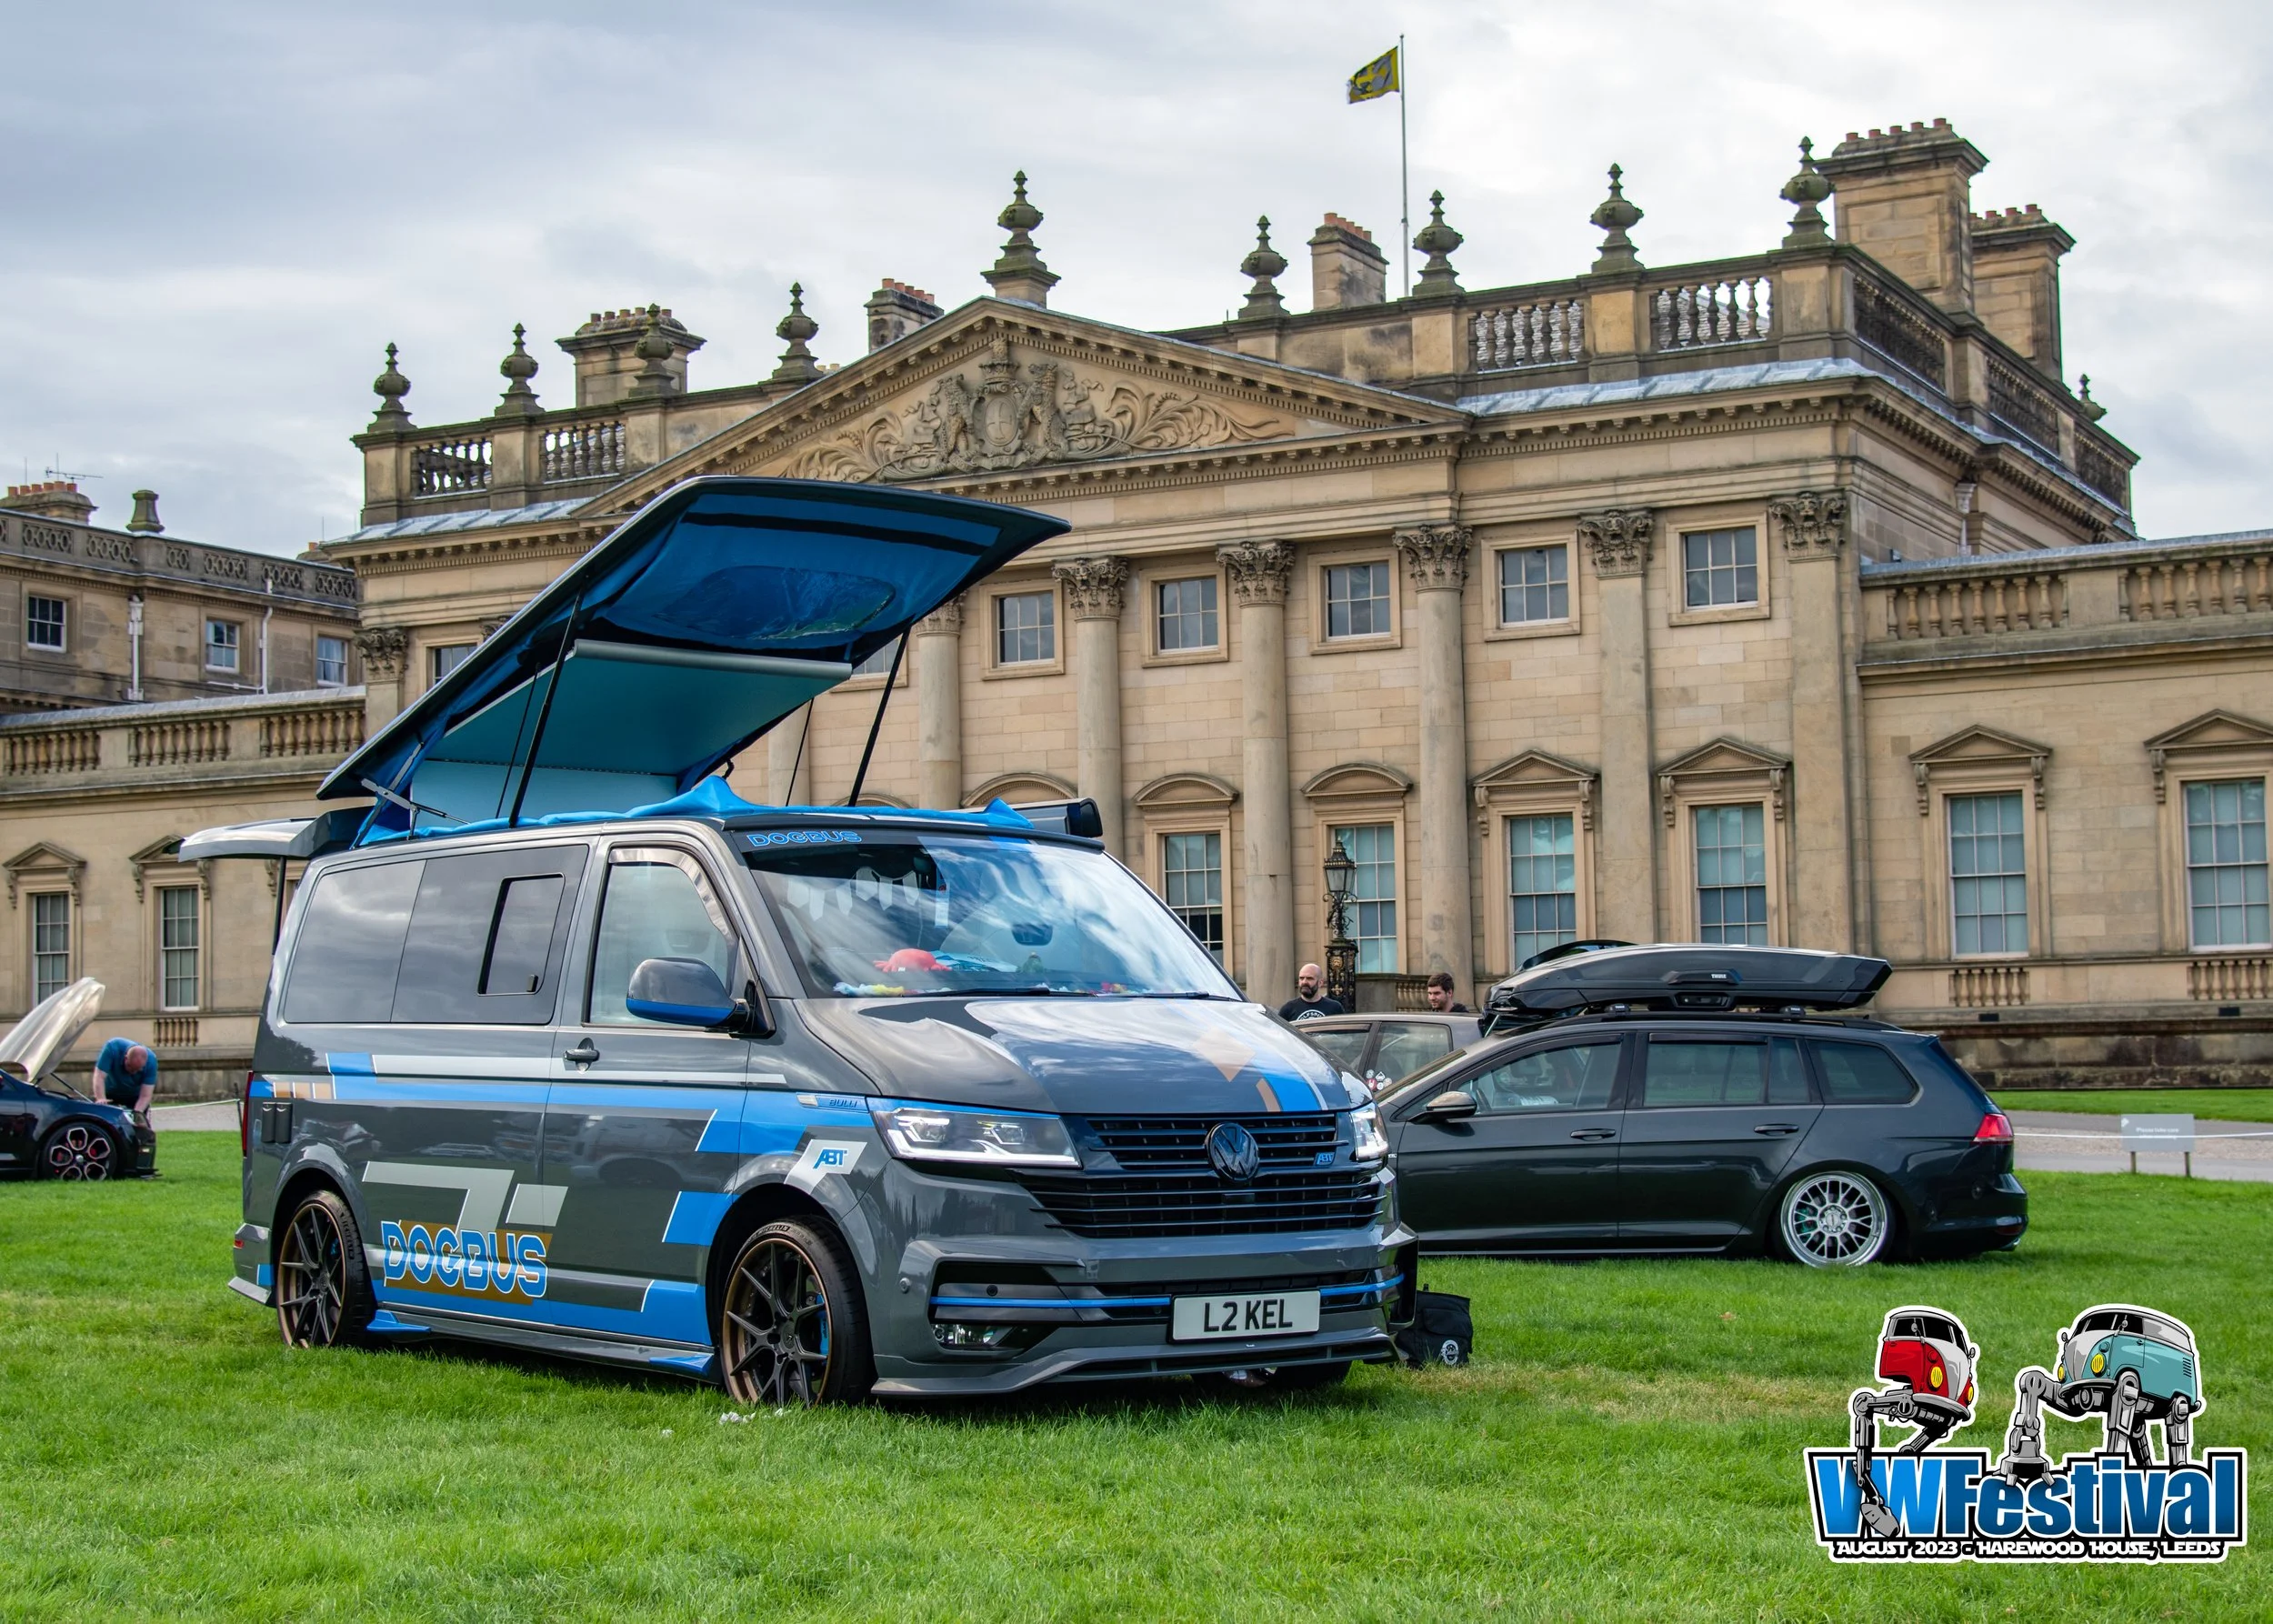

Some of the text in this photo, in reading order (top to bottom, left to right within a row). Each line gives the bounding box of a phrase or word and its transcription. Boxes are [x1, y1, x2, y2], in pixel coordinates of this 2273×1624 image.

[829, 1098, 858, 1108] BULLI
[813, 1149, 847, 1169] ABT
[1203, 1298, 1293, 1333] L2 KEL
